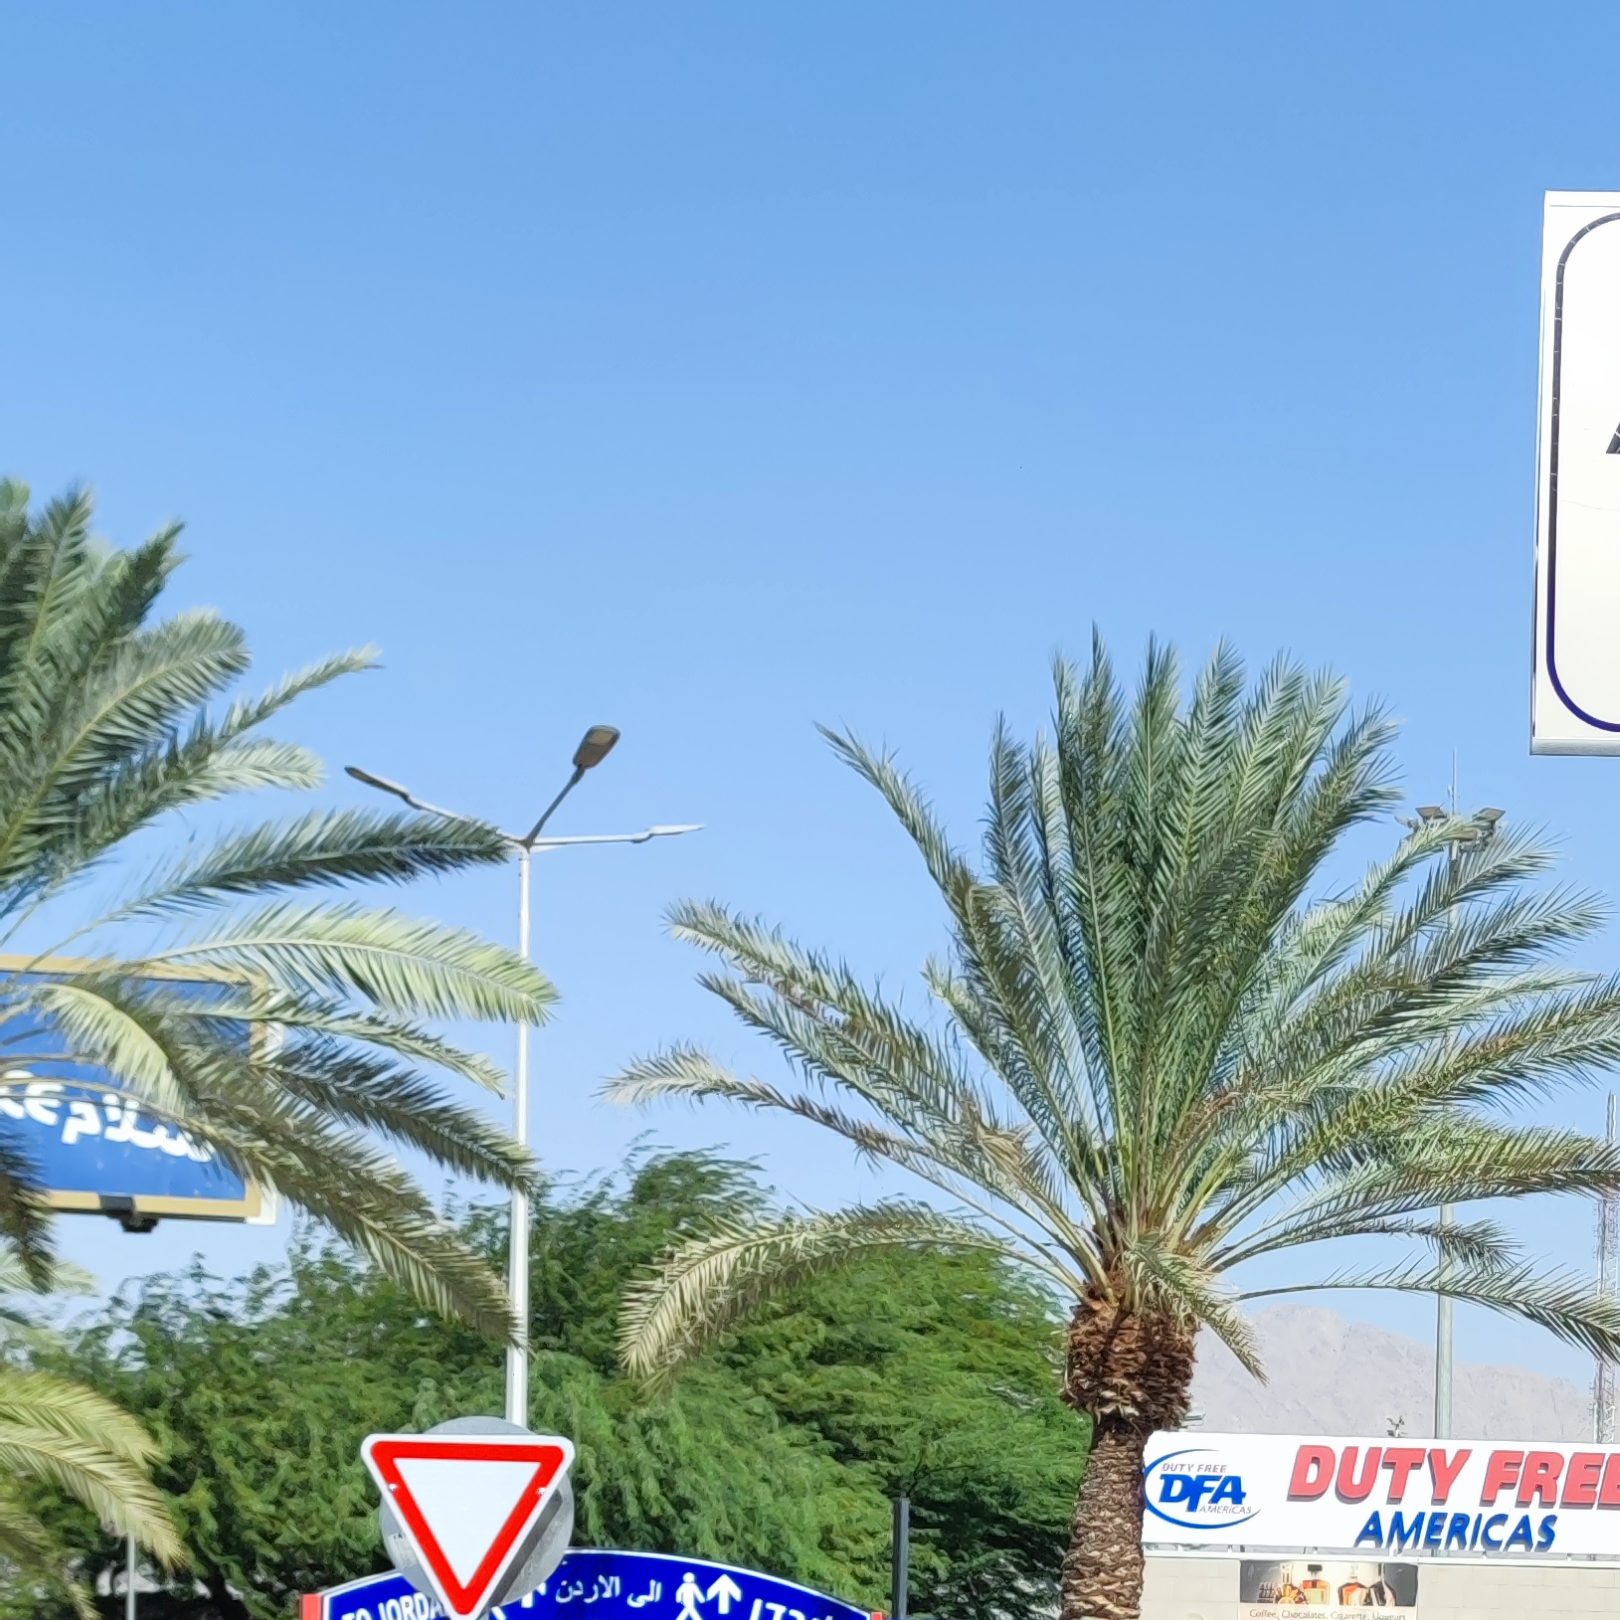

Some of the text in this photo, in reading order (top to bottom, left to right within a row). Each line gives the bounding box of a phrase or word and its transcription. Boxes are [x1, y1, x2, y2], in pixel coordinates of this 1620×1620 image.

[1161, 1462, 1228, 1474] DUTY FREE
[1286, 1444, 1472, 1507] DUTY
[1158, 1473, 1247, 1513] DFA
[1353, 1510, 1559, 1553] AMERICAS
